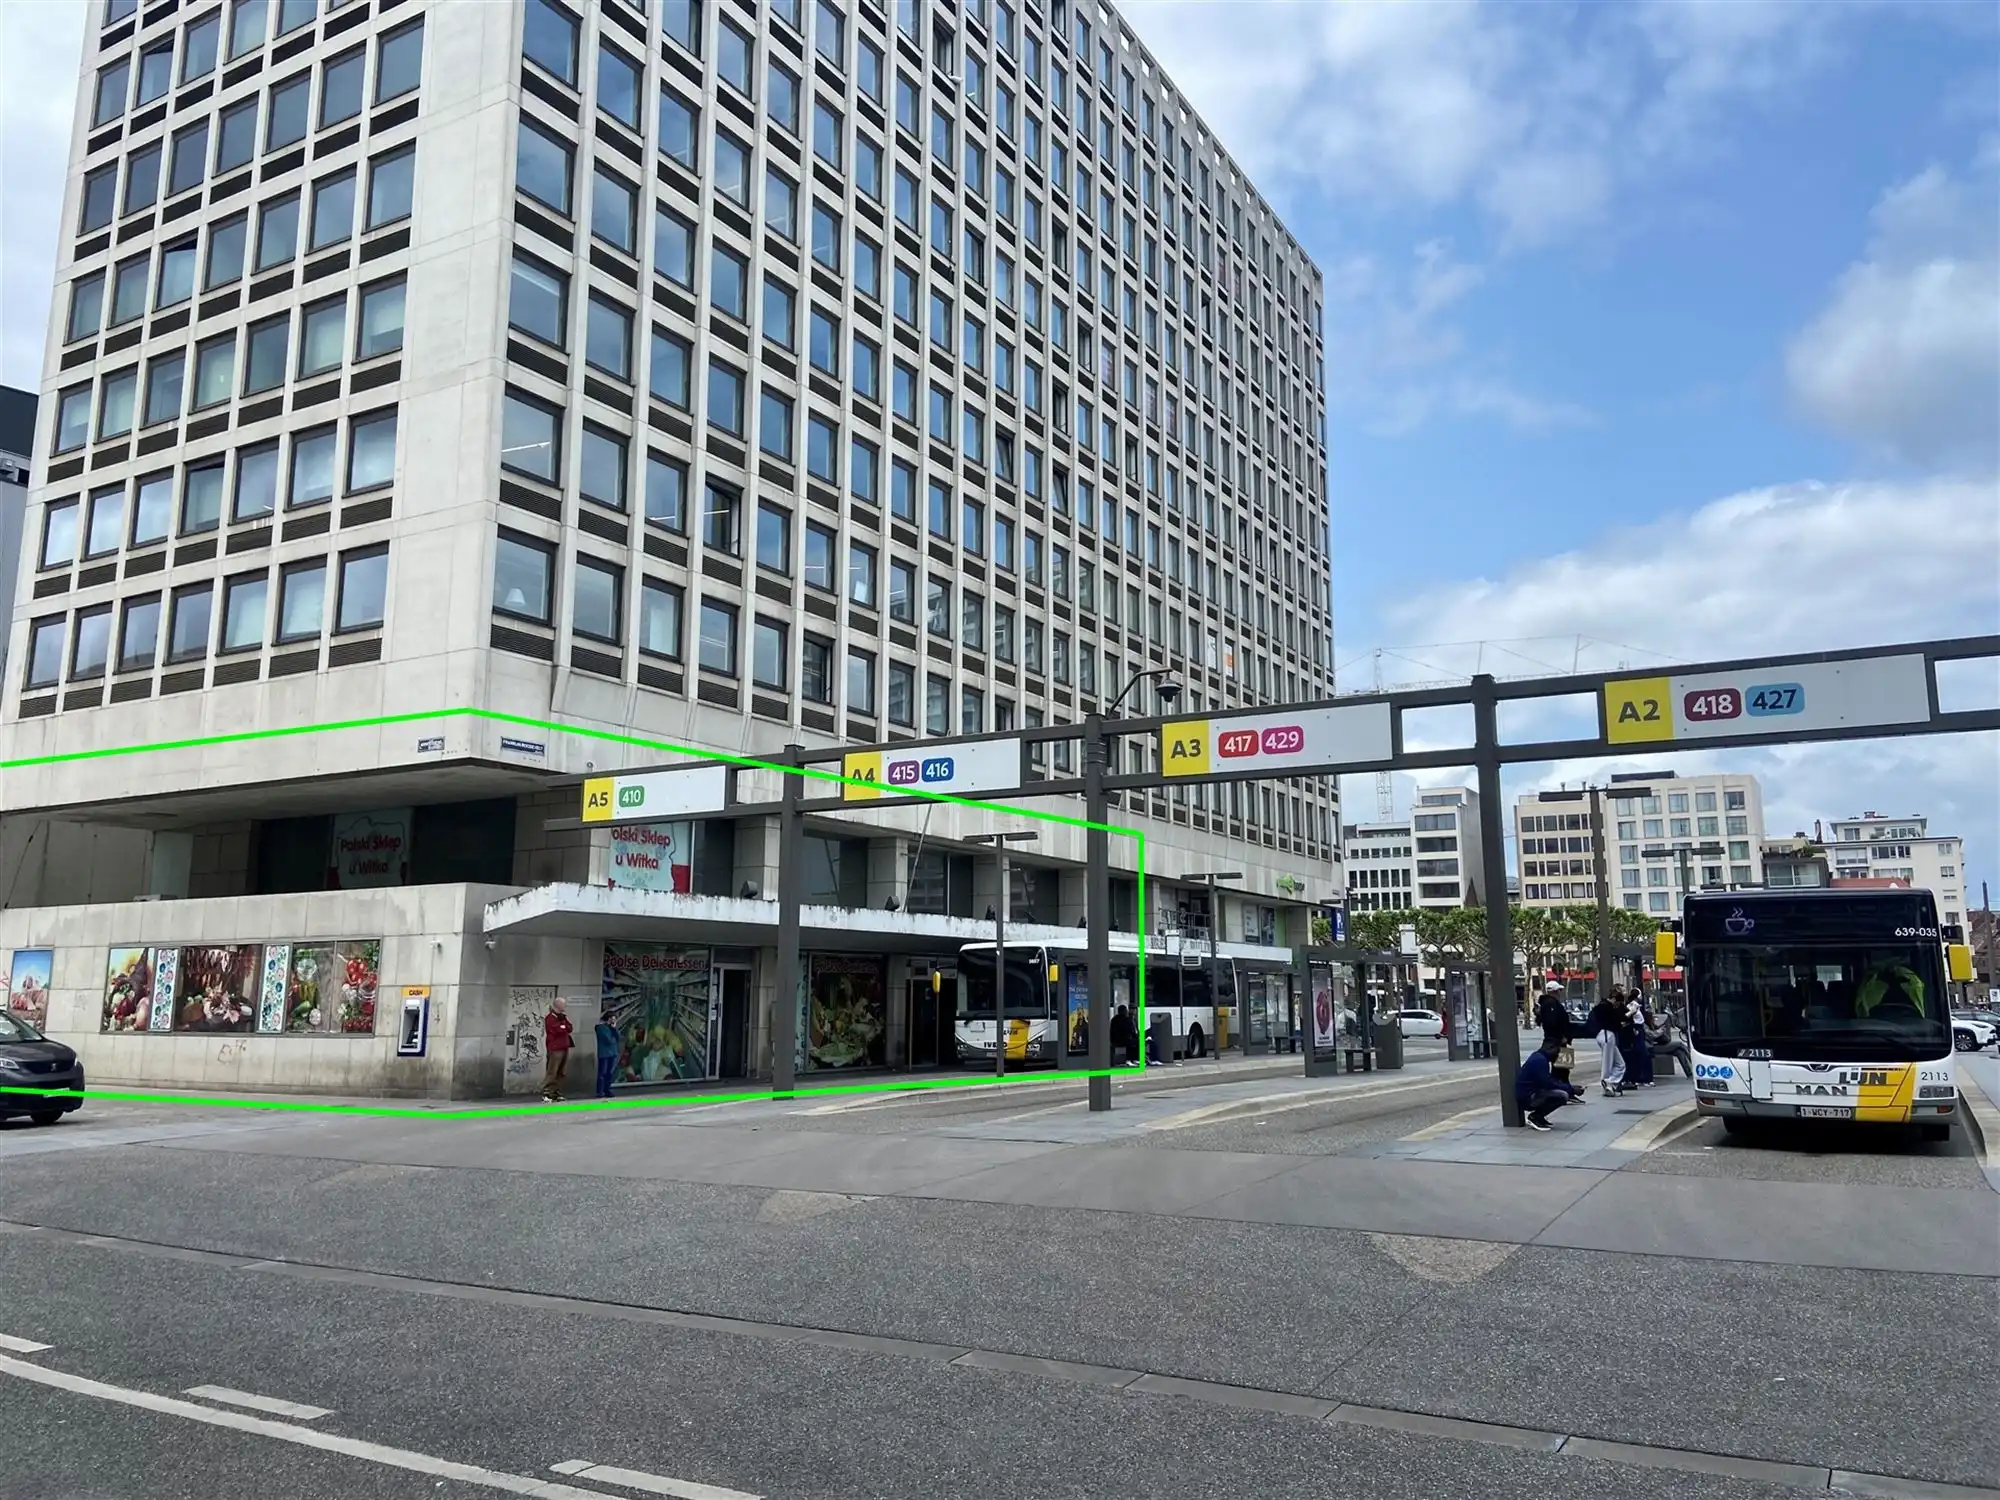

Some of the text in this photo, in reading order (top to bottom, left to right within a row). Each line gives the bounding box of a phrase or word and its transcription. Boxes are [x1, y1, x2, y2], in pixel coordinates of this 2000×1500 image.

[1618, 689, 1797, 723] A2 418 427
[1170, 731, 1300, 759] A3 417 429
[852, 762, 949, 785] A4 415 416
[588, 789, 641, 808] A5 410
[341, 833, 402, 852] Polski Sklep
[611, 825, 671, 848] olski Sklep
[615, 852, 659, 869] u Witka
[1895, 927, 1938, 937] 639-035
[604, 953, 639, 969] Poolse
[1749, 1049, 1772, 1058] 2113
[1920, 1071, 1949, 1082] 2113
[1796, 1084, 1848, 1096] MAN
